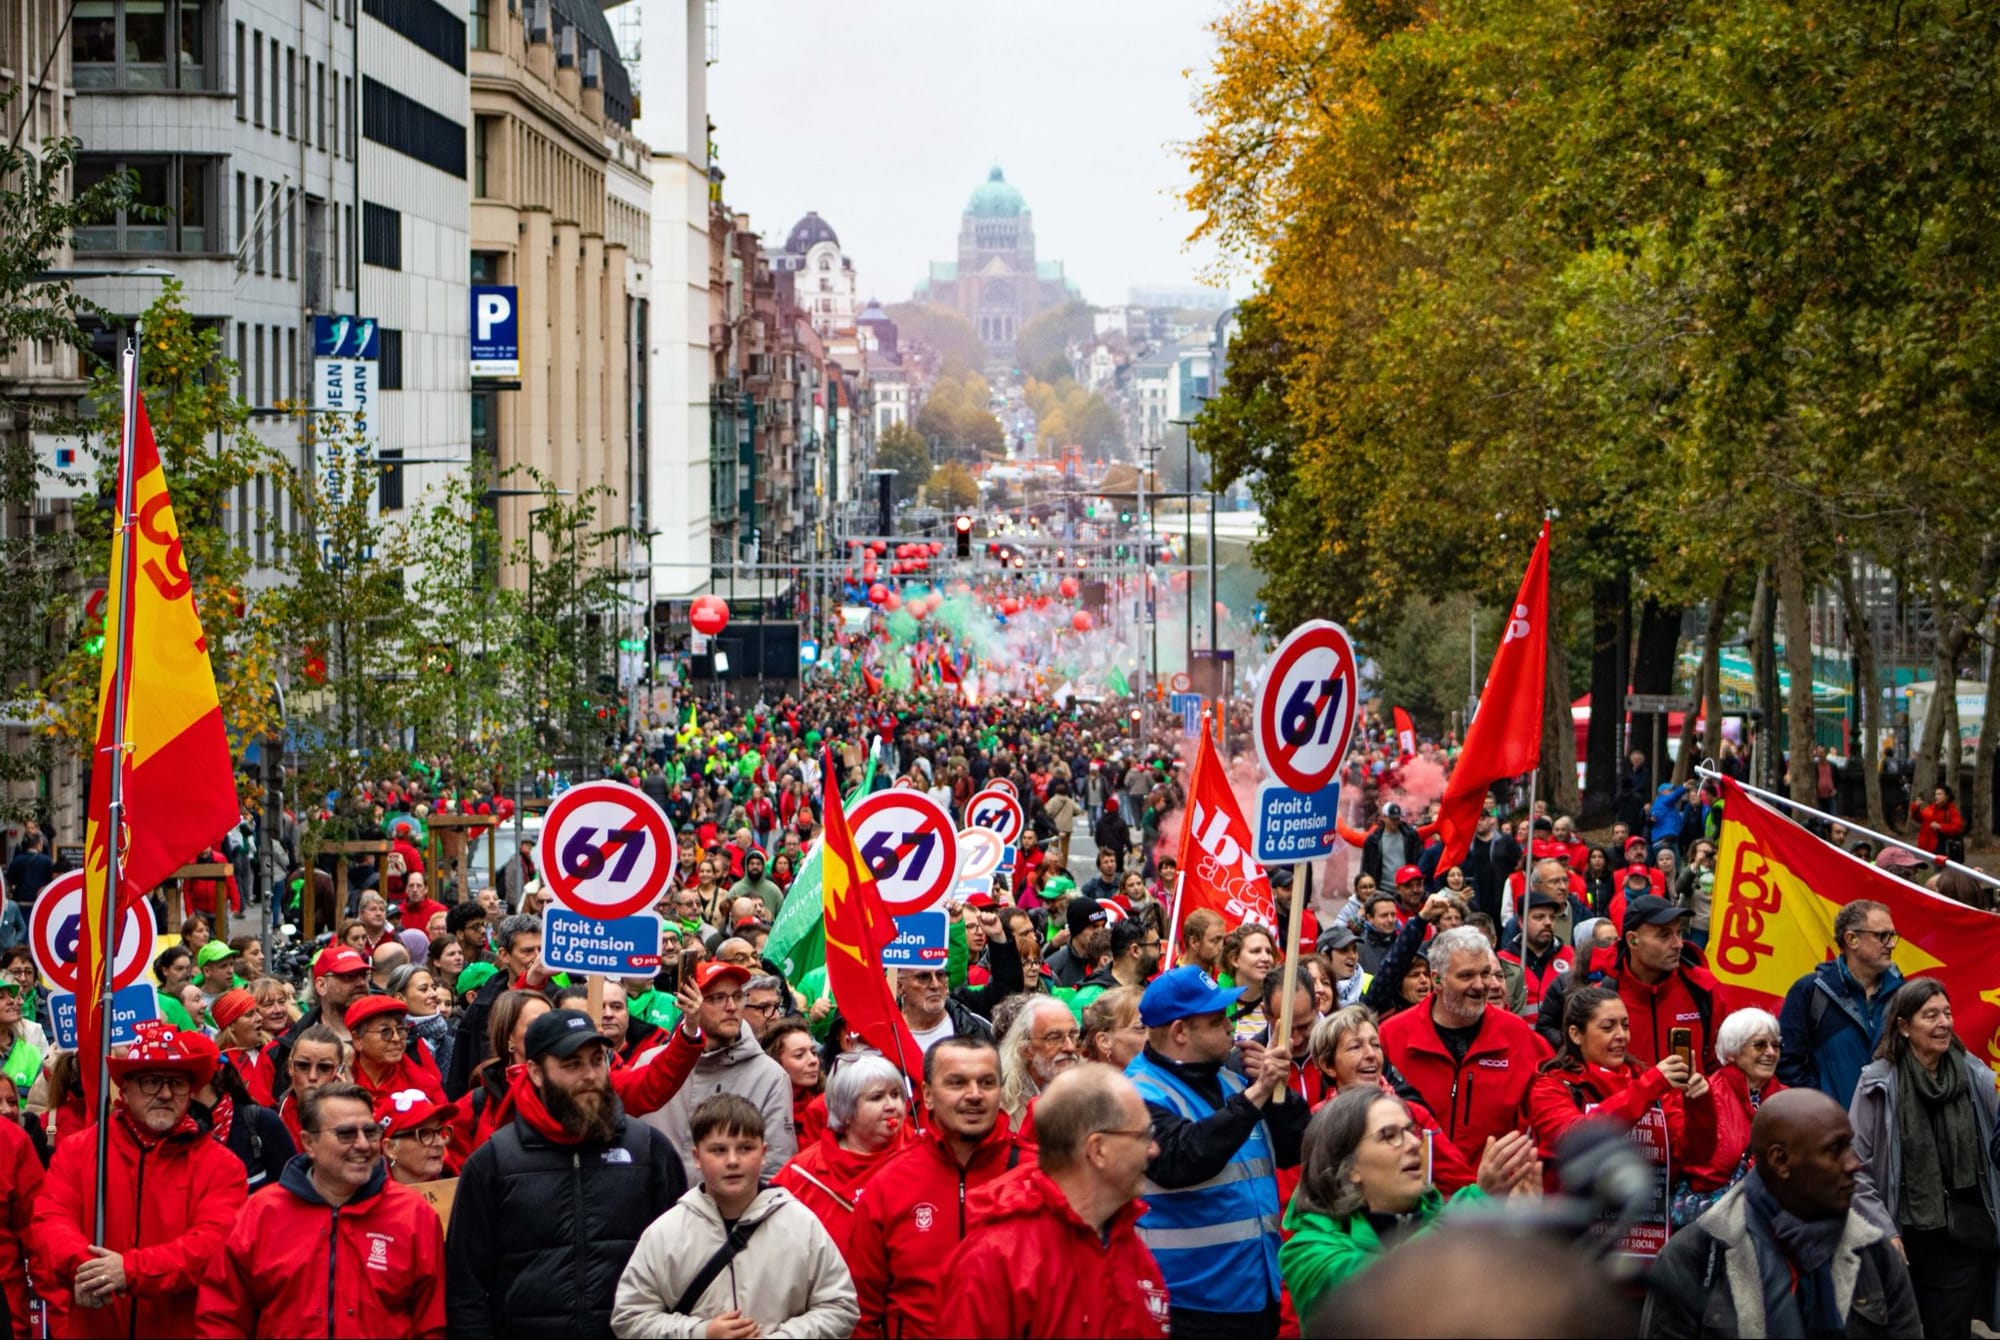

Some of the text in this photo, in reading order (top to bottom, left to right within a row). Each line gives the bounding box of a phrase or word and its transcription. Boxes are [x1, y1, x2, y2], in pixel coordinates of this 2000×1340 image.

[478, 293, 511, 341] P
[327, 363, 343, 408] JEAN
[1281, 678, 1343, 747] 67
[1268, 797, 1312, 815] droit à
[975, 808, 1011, 833] 67
[1267, 813, 1327, 836] la pension
[1265, 833, 1275, 852] à
[1278, 834, 1295, 851] 65
[1297, 835, 1317, 850] ans
[562, 826, 647, 883] 67
[860, 830, 936, 882] 67
[552, 918, 605, 936] droit à
[552, 932, 635, 952] la pension
[551, 947, 618, 966] à 65 ans
[883, 948, 910, 959] ans
[60, 1016, 73, 1028] la
